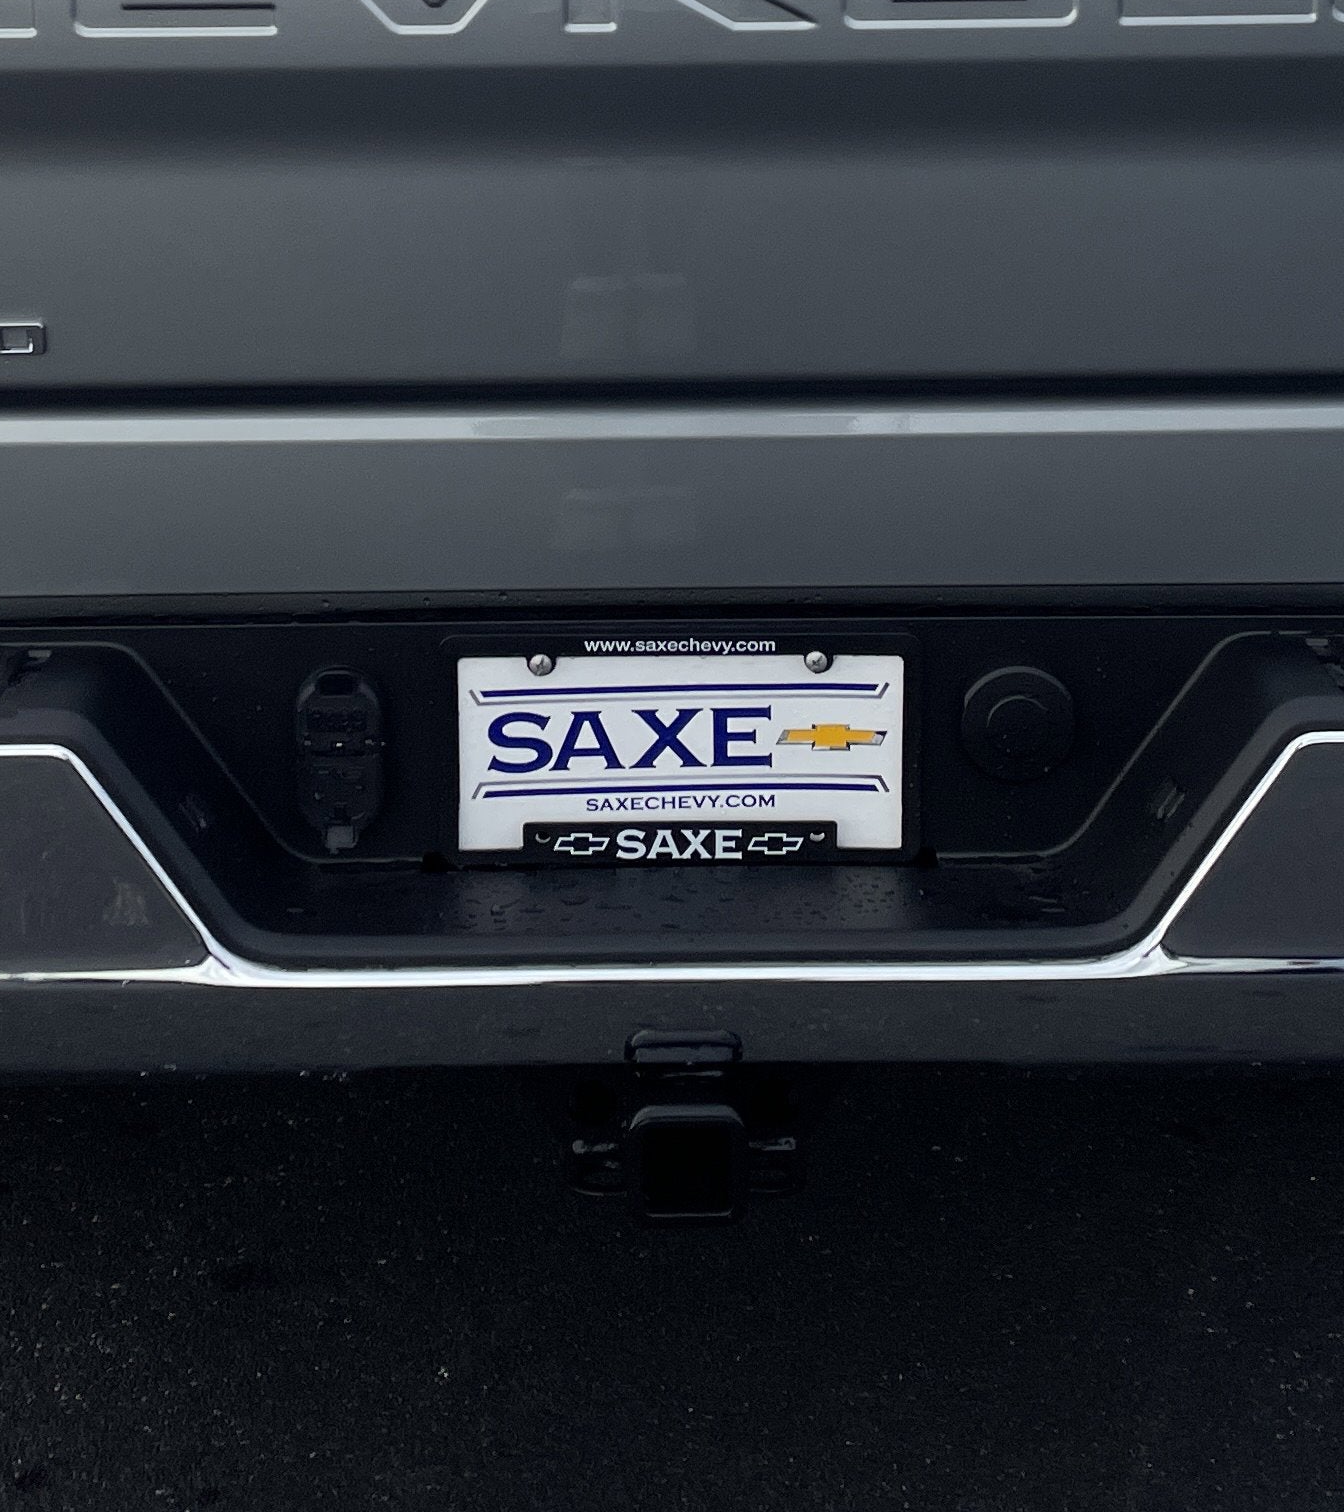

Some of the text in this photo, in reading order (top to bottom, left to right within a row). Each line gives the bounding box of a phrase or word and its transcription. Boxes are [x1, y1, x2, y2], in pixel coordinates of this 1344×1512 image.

[584, 639, 776, 654] www.saxechevy.com
[487, 705, 773, 773] SAXE
[586, 794, 776, 812] SAXECHEVY.COM
[616, 828, 743, 860] SAXE
